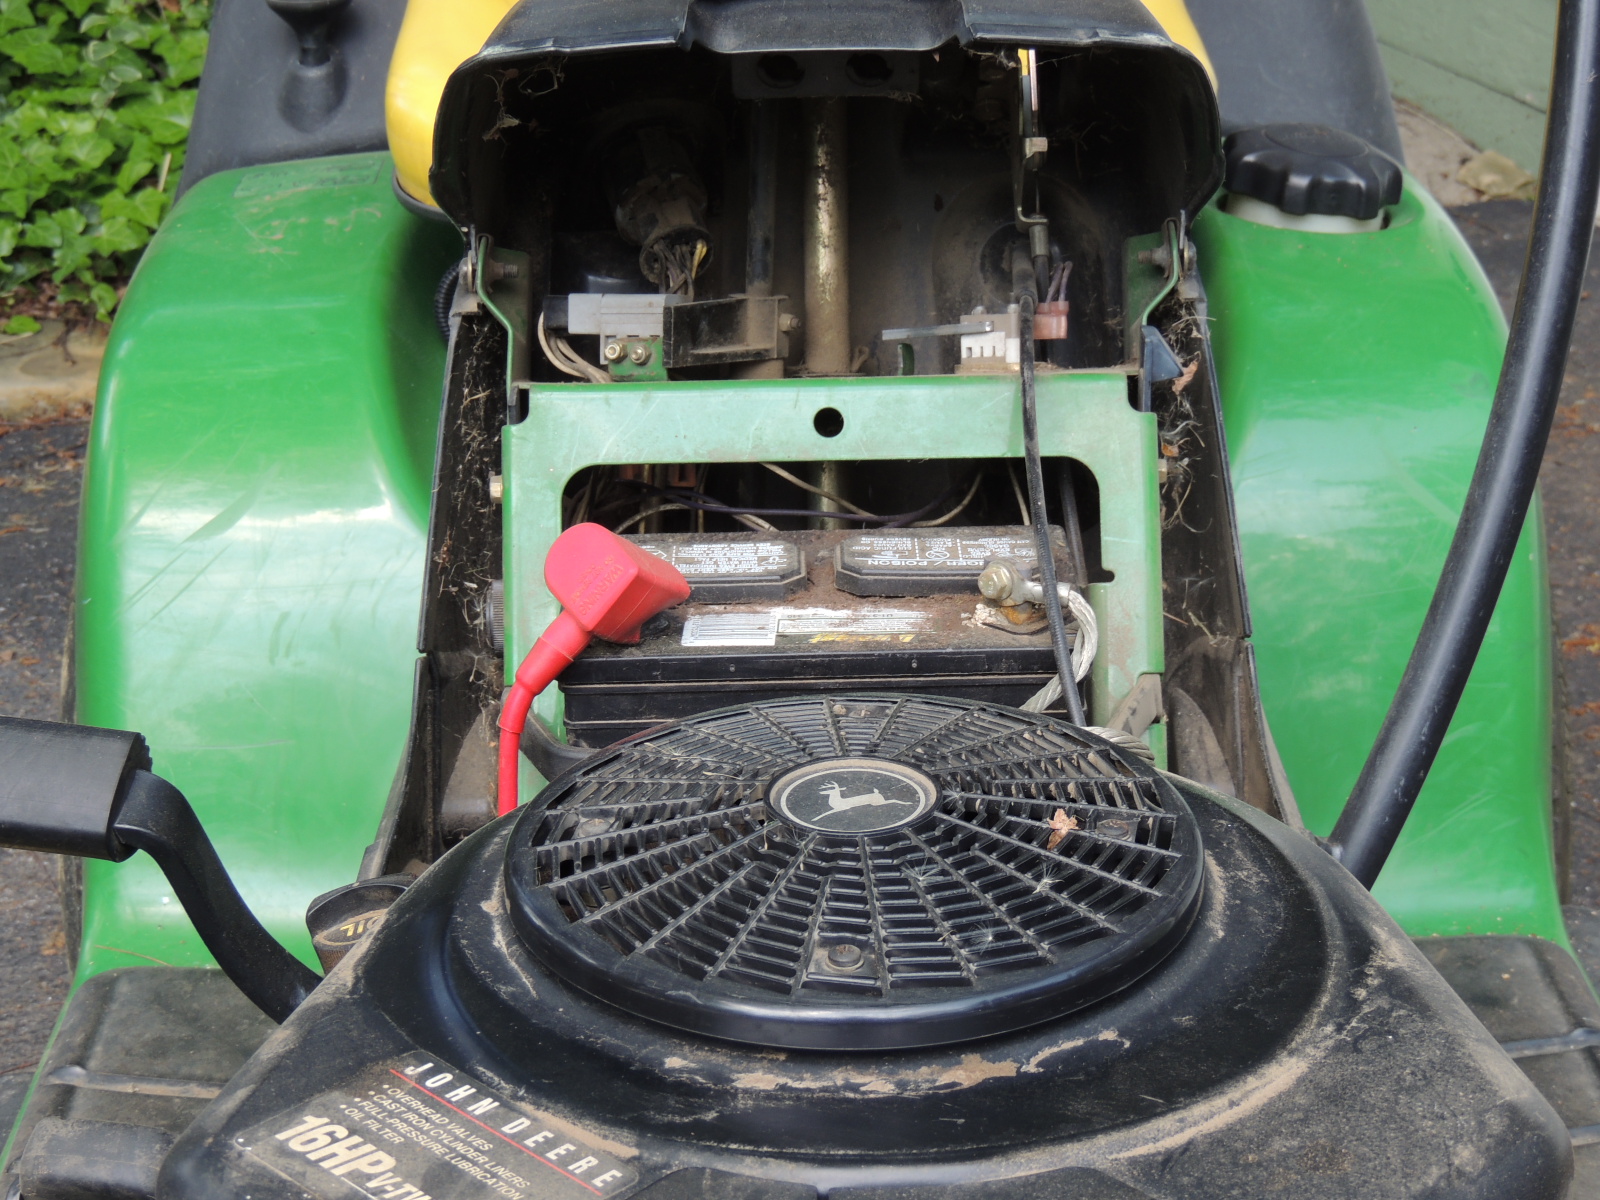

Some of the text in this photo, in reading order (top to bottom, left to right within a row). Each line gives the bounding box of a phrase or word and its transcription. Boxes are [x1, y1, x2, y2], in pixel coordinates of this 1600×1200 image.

[275, 1115, 397, 1176] 16HP
[344, 1107, 405, 1144] OIL FILTER
[357, 1100, 525, 1200] FULL-PRESSURE LUBRICATION
[373, 1094, 531, 1188] CAST IRON CYLINDER LINERS
[387, 1088, 493, 1151] OVERHEAD VALVES
[404, 1062, 623, 1187] JOHN DEERE
